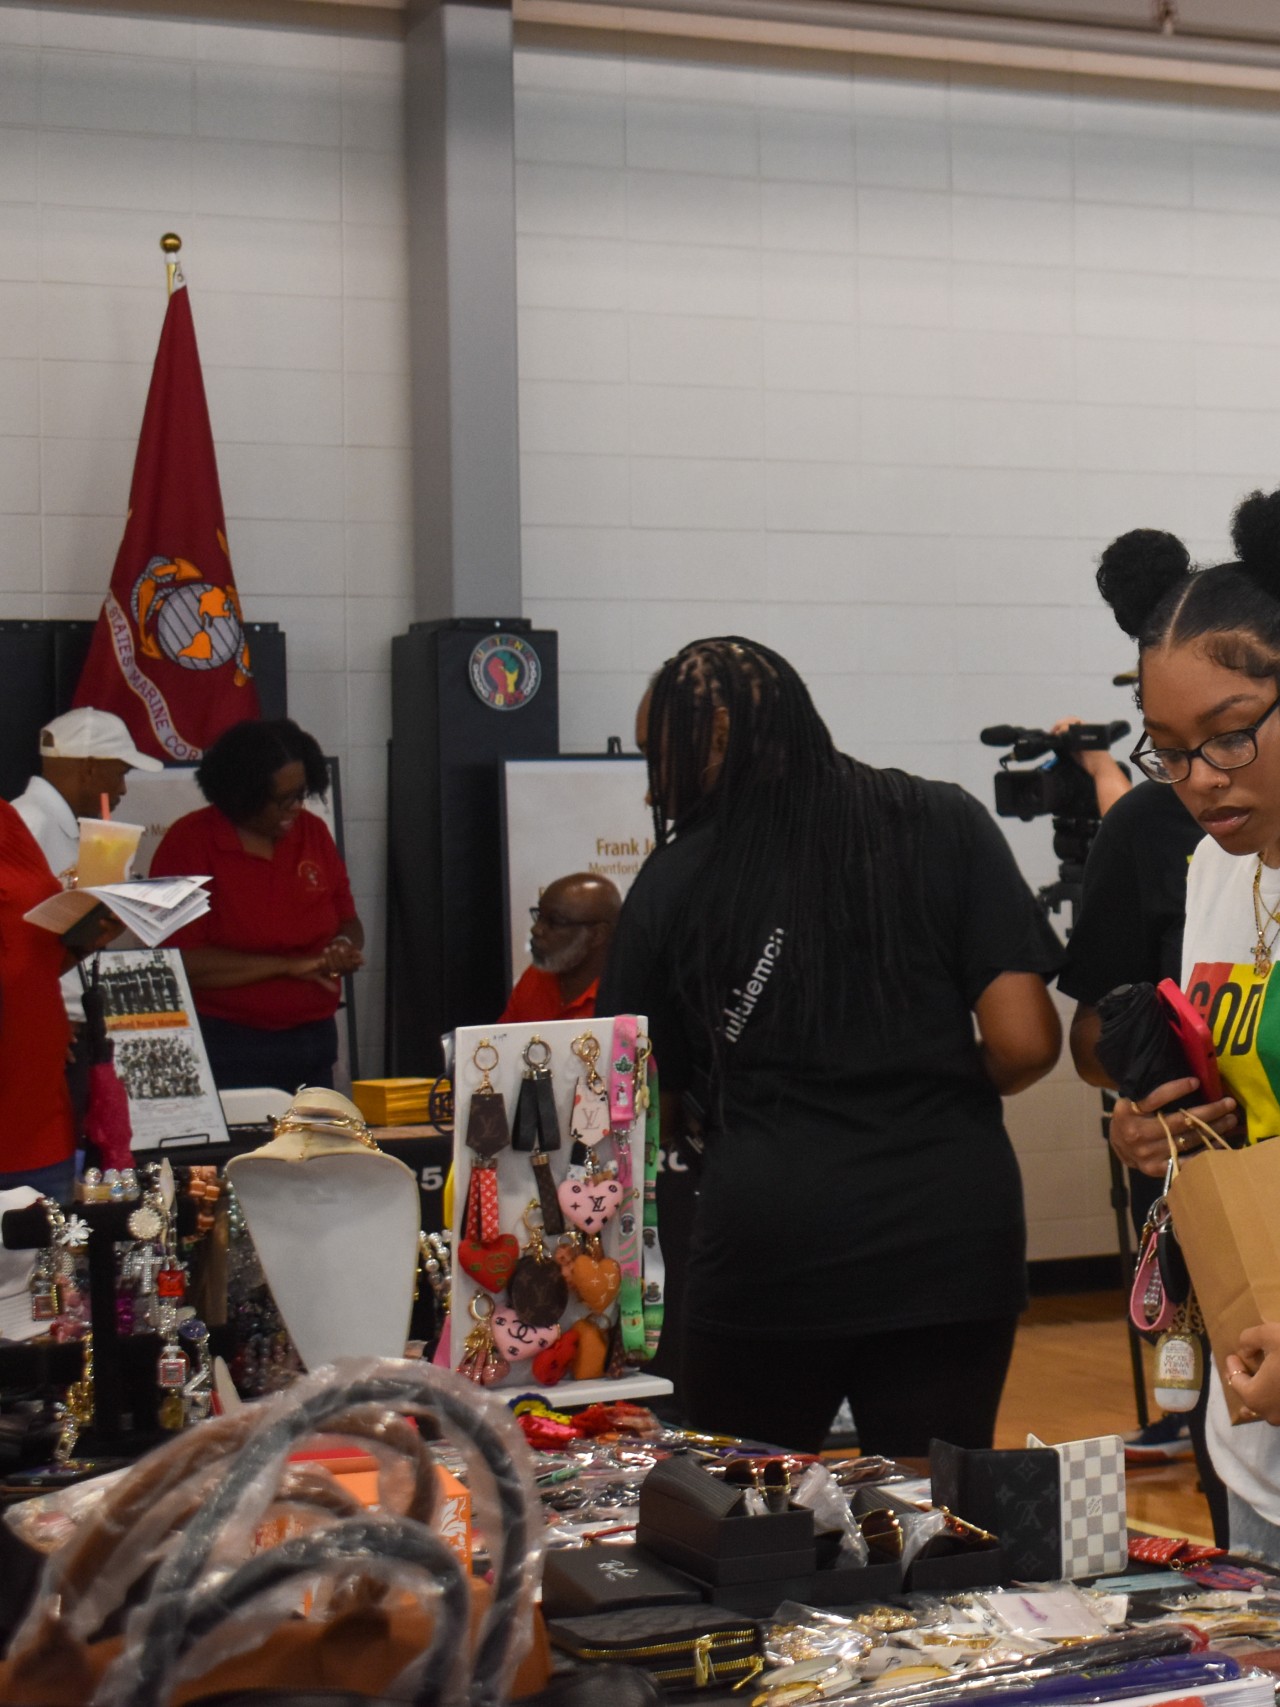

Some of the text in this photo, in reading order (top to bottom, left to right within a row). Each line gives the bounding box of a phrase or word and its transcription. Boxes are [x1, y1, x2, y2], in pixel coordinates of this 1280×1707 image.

[109, 606, 134, 668] STATES
[128, 669, 170, 731] MARINE
[595, 837, 640, 856] Frank
